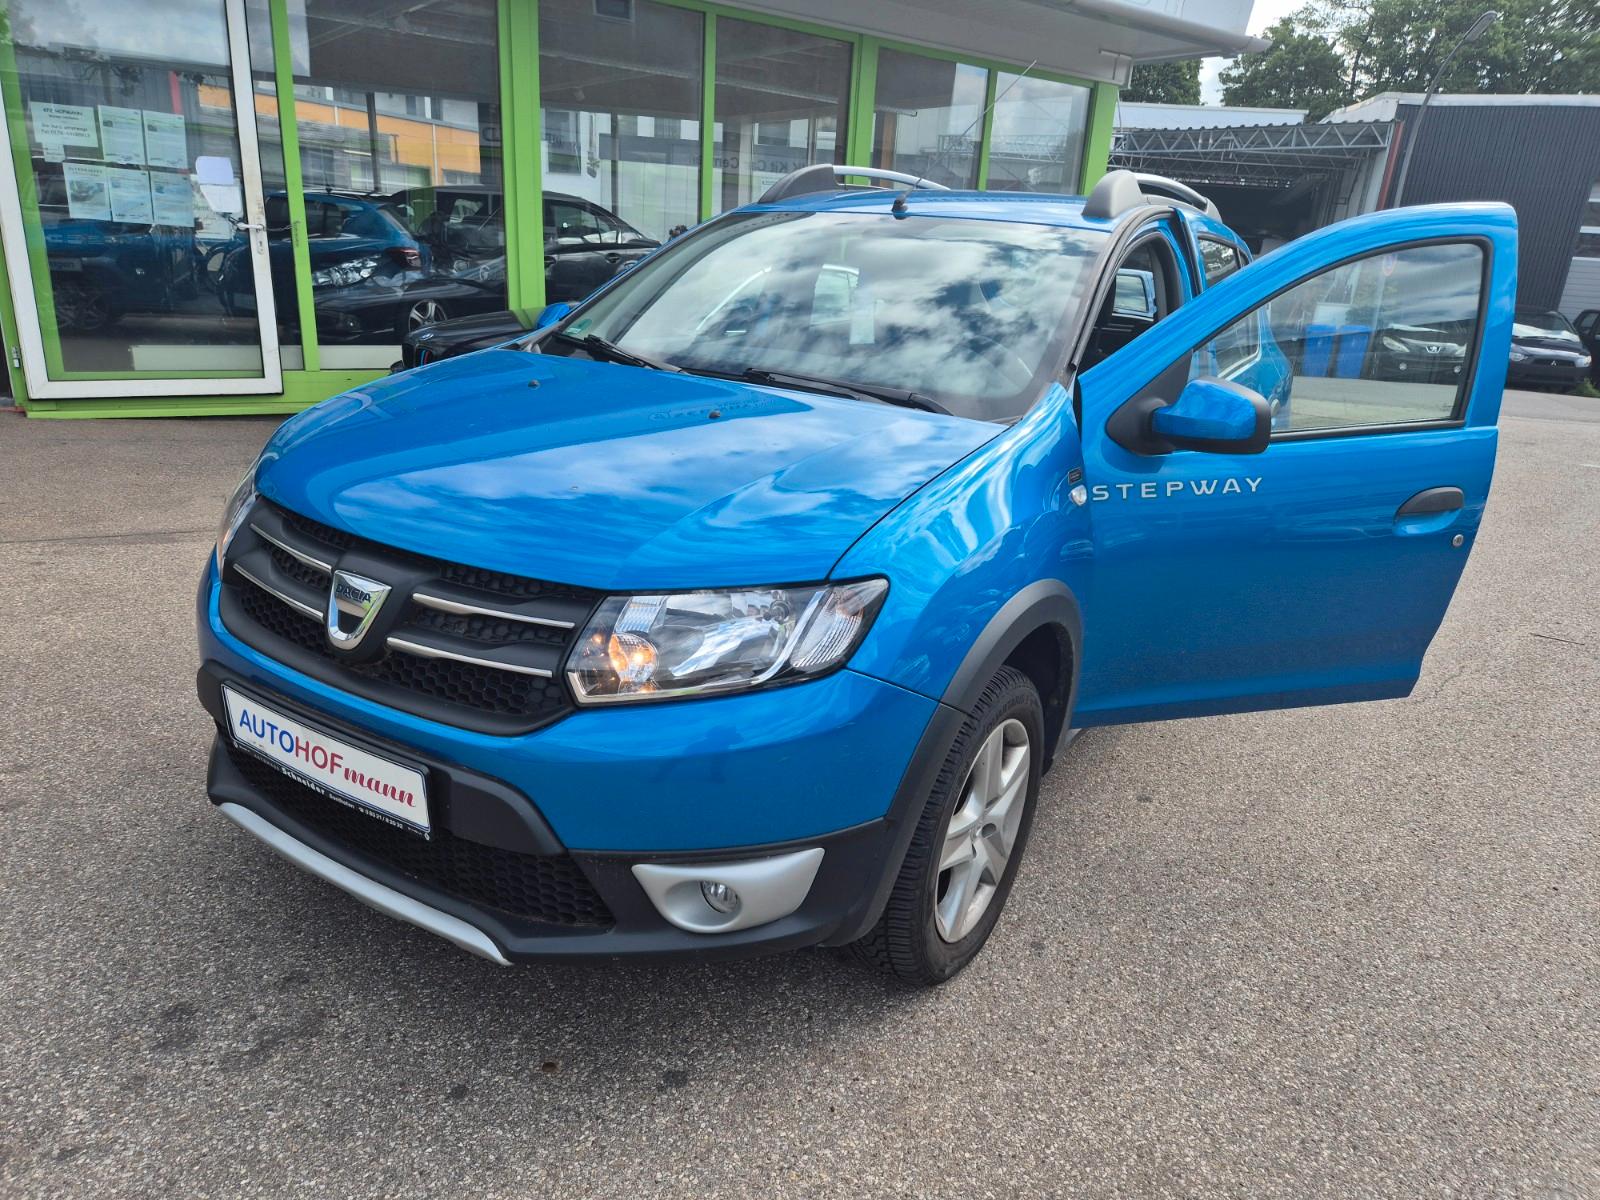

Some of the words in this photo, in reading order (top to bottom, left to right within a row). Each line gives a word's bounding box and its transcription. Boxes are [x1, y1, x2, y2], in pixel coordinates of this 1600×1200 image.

[1092, 477, 1262, 501] STEPWAY
[336, 583, 371, 603] DACIA
[281, 767, 325, 795] Schneider
